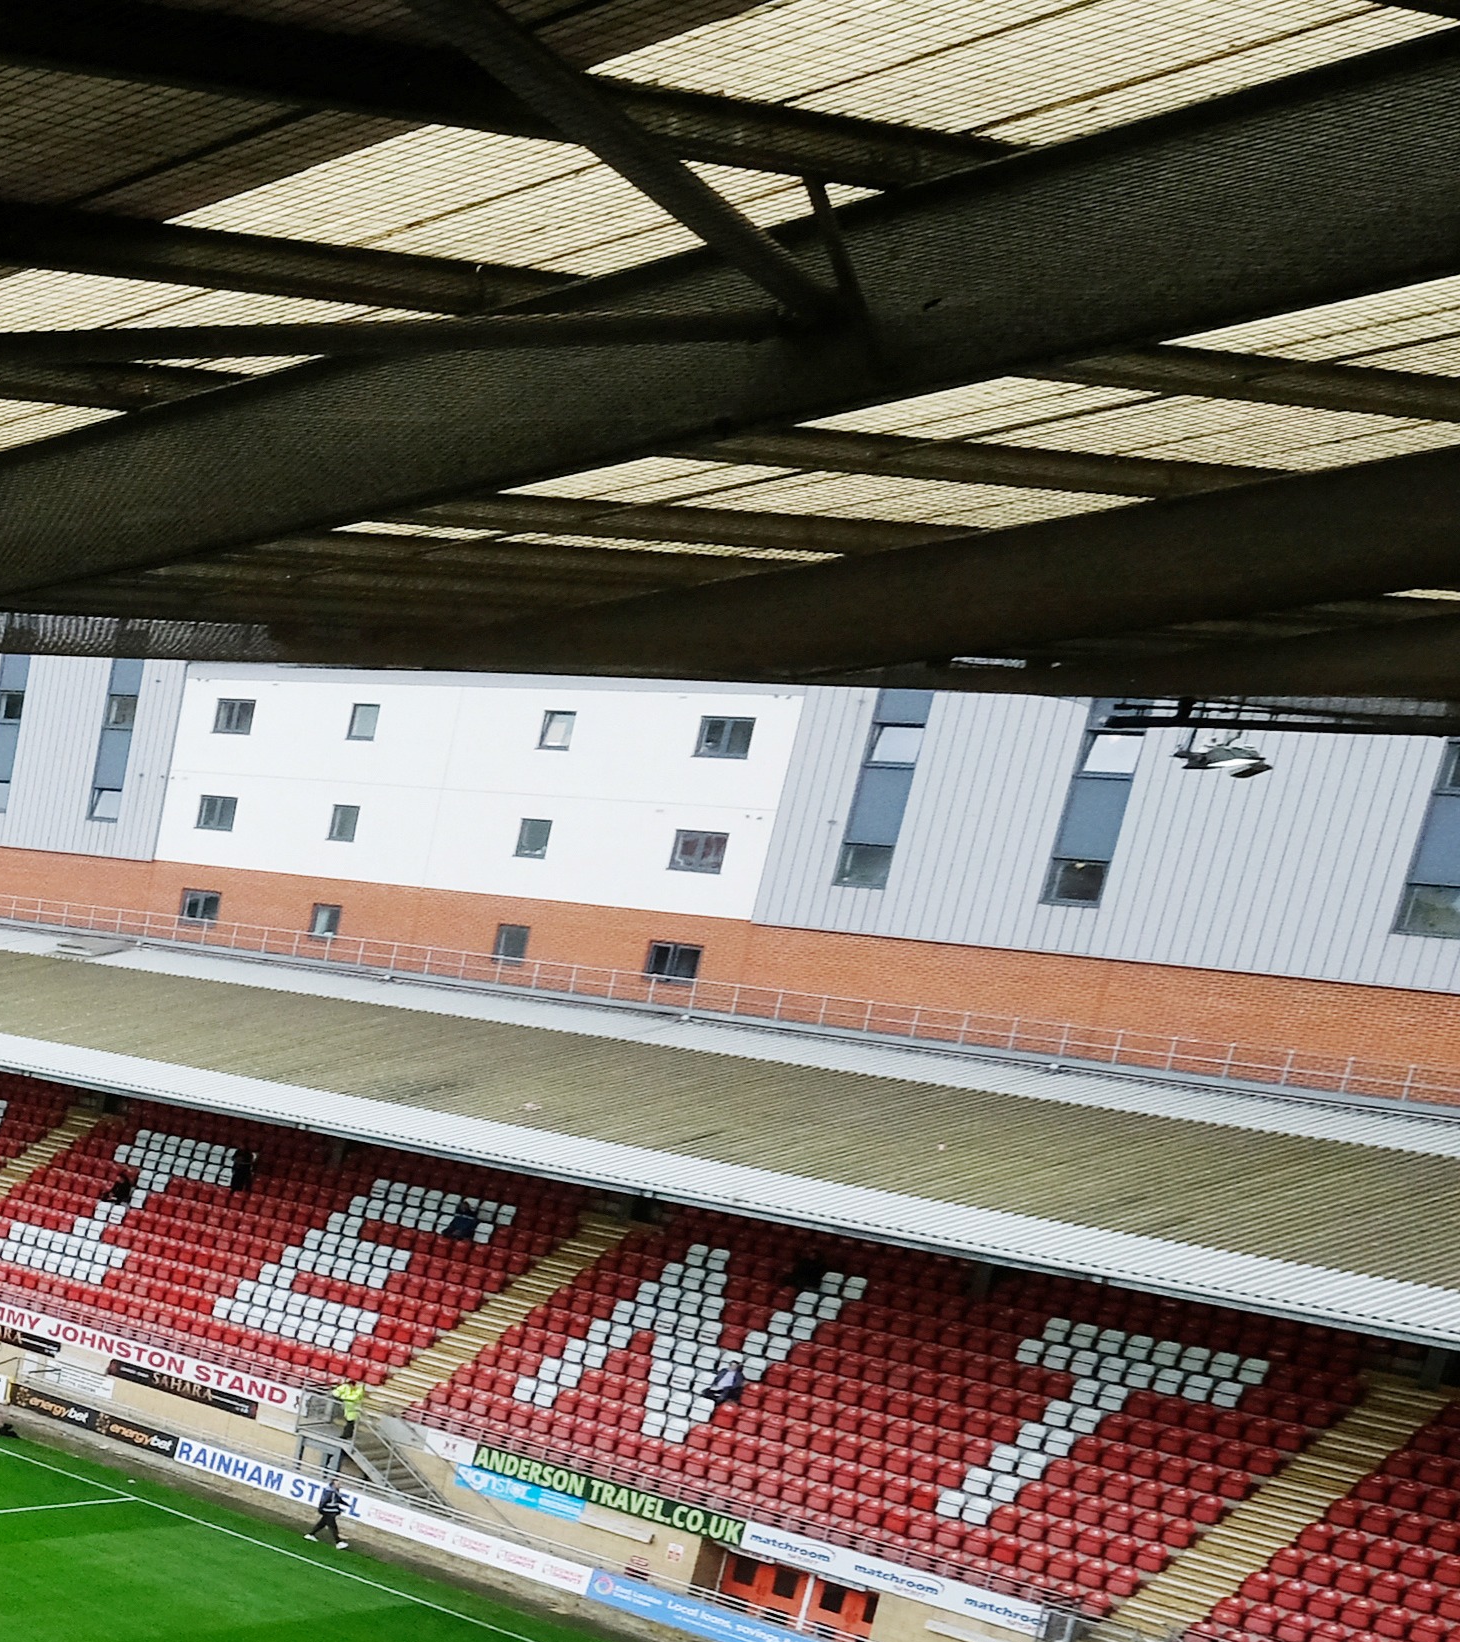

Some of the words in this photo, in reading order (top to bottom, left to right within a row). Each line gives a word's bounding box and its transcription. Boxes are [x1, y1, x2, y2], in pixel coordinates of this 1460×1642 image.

[46, 1319, 186, 1376] JOHNSTON
[193, 1361, 289, 1405] STAND
[151, 1371, 213, 1402] SAHARA
[29, 1395, 89, 1425] energybet
[109, 1420, 172, 1452] energybet
[177, 1440, 283, 1492] RAINHAM
[473, 1446, 586, 1498] ANDERSON
[590, 1478, 744, 1545] TRAVEL.CO.UK
[750, 1531, 831, 1562] matchroom
[855, 1562, 939, 1596] matchroom
